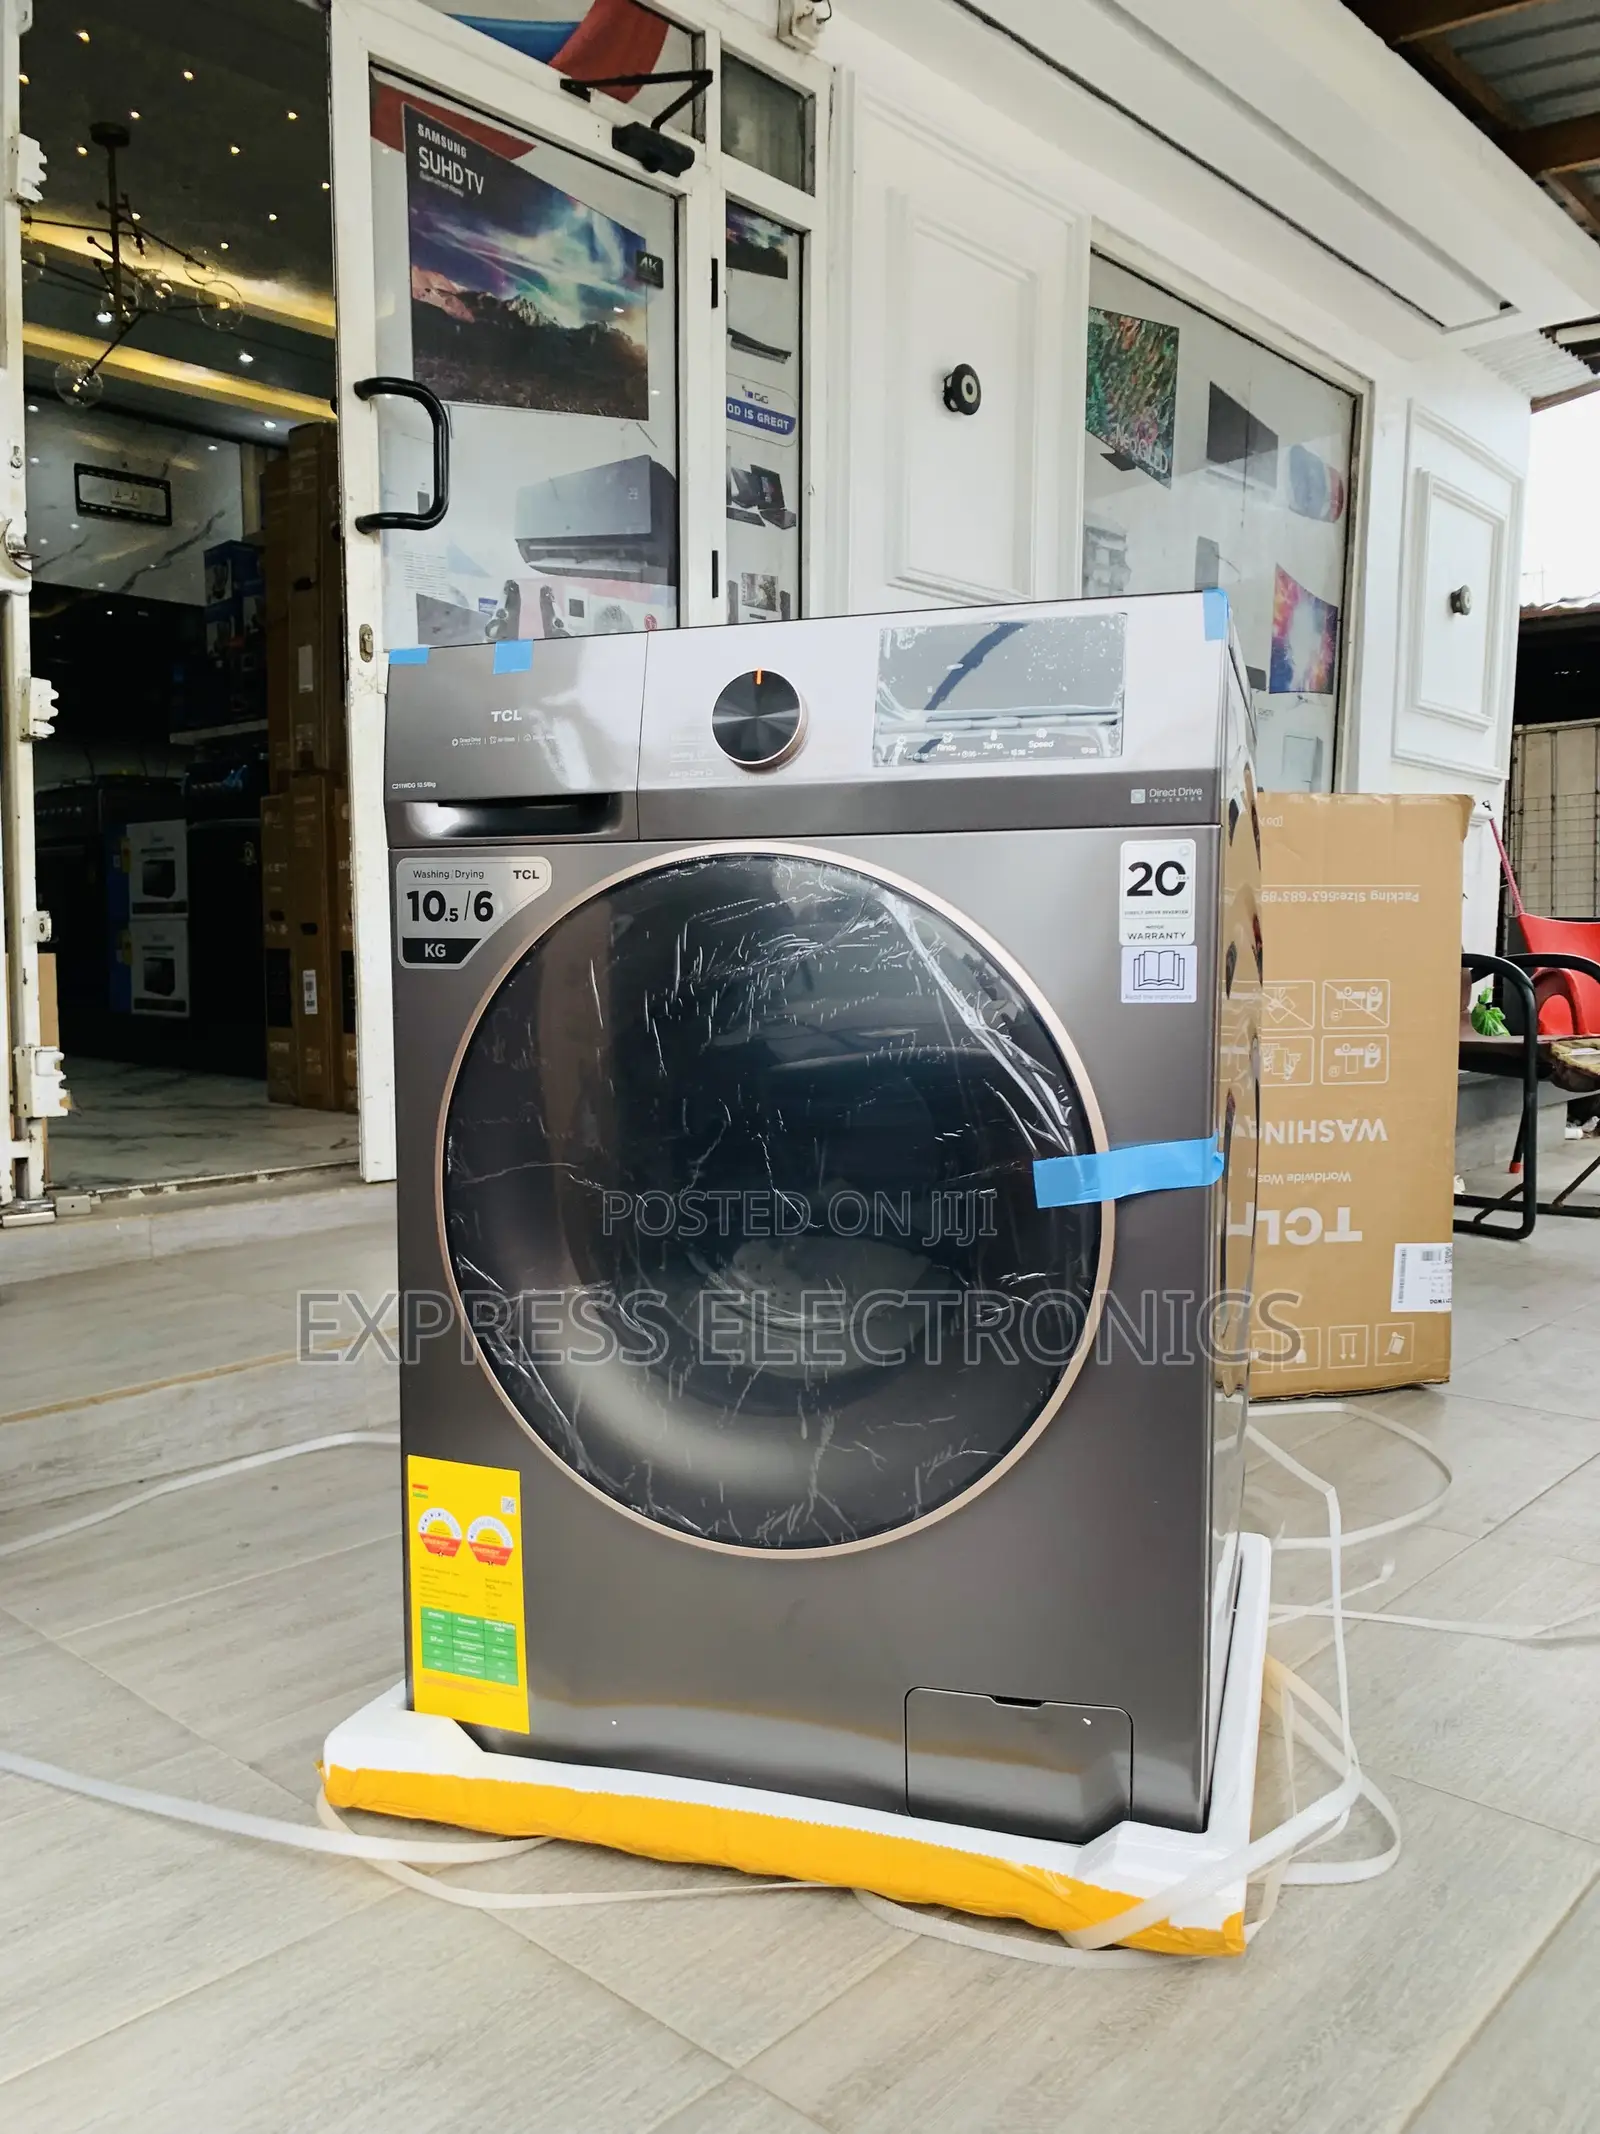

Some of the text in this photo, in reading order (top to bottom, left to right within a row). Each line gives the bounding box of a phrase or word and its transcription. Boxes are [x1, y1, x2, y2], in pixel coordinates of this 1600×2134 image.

[418, 123, 467, 159] SAMSUNG
[419, 146, 464, 185] SUHD
[465, 167, 484, 195] TV
[726, 403, 789, 431] OD IS GREAT
[490, 709, 522, 723] TCL
[1149, 786, 1203, 798] Direct Drive
[413, 869, 484, 880] Washing Drying
[513, 869, 540, 880] TCL
[1371, 891, 1419, 903] Packing
[1127, 931, 1187, 941] WARRANTY
[424, 943, 447, 958] KG
[1257, 1171, 1352, 1184] Worldwide Was
[1256, 1207, 1363, 1246] TCL
